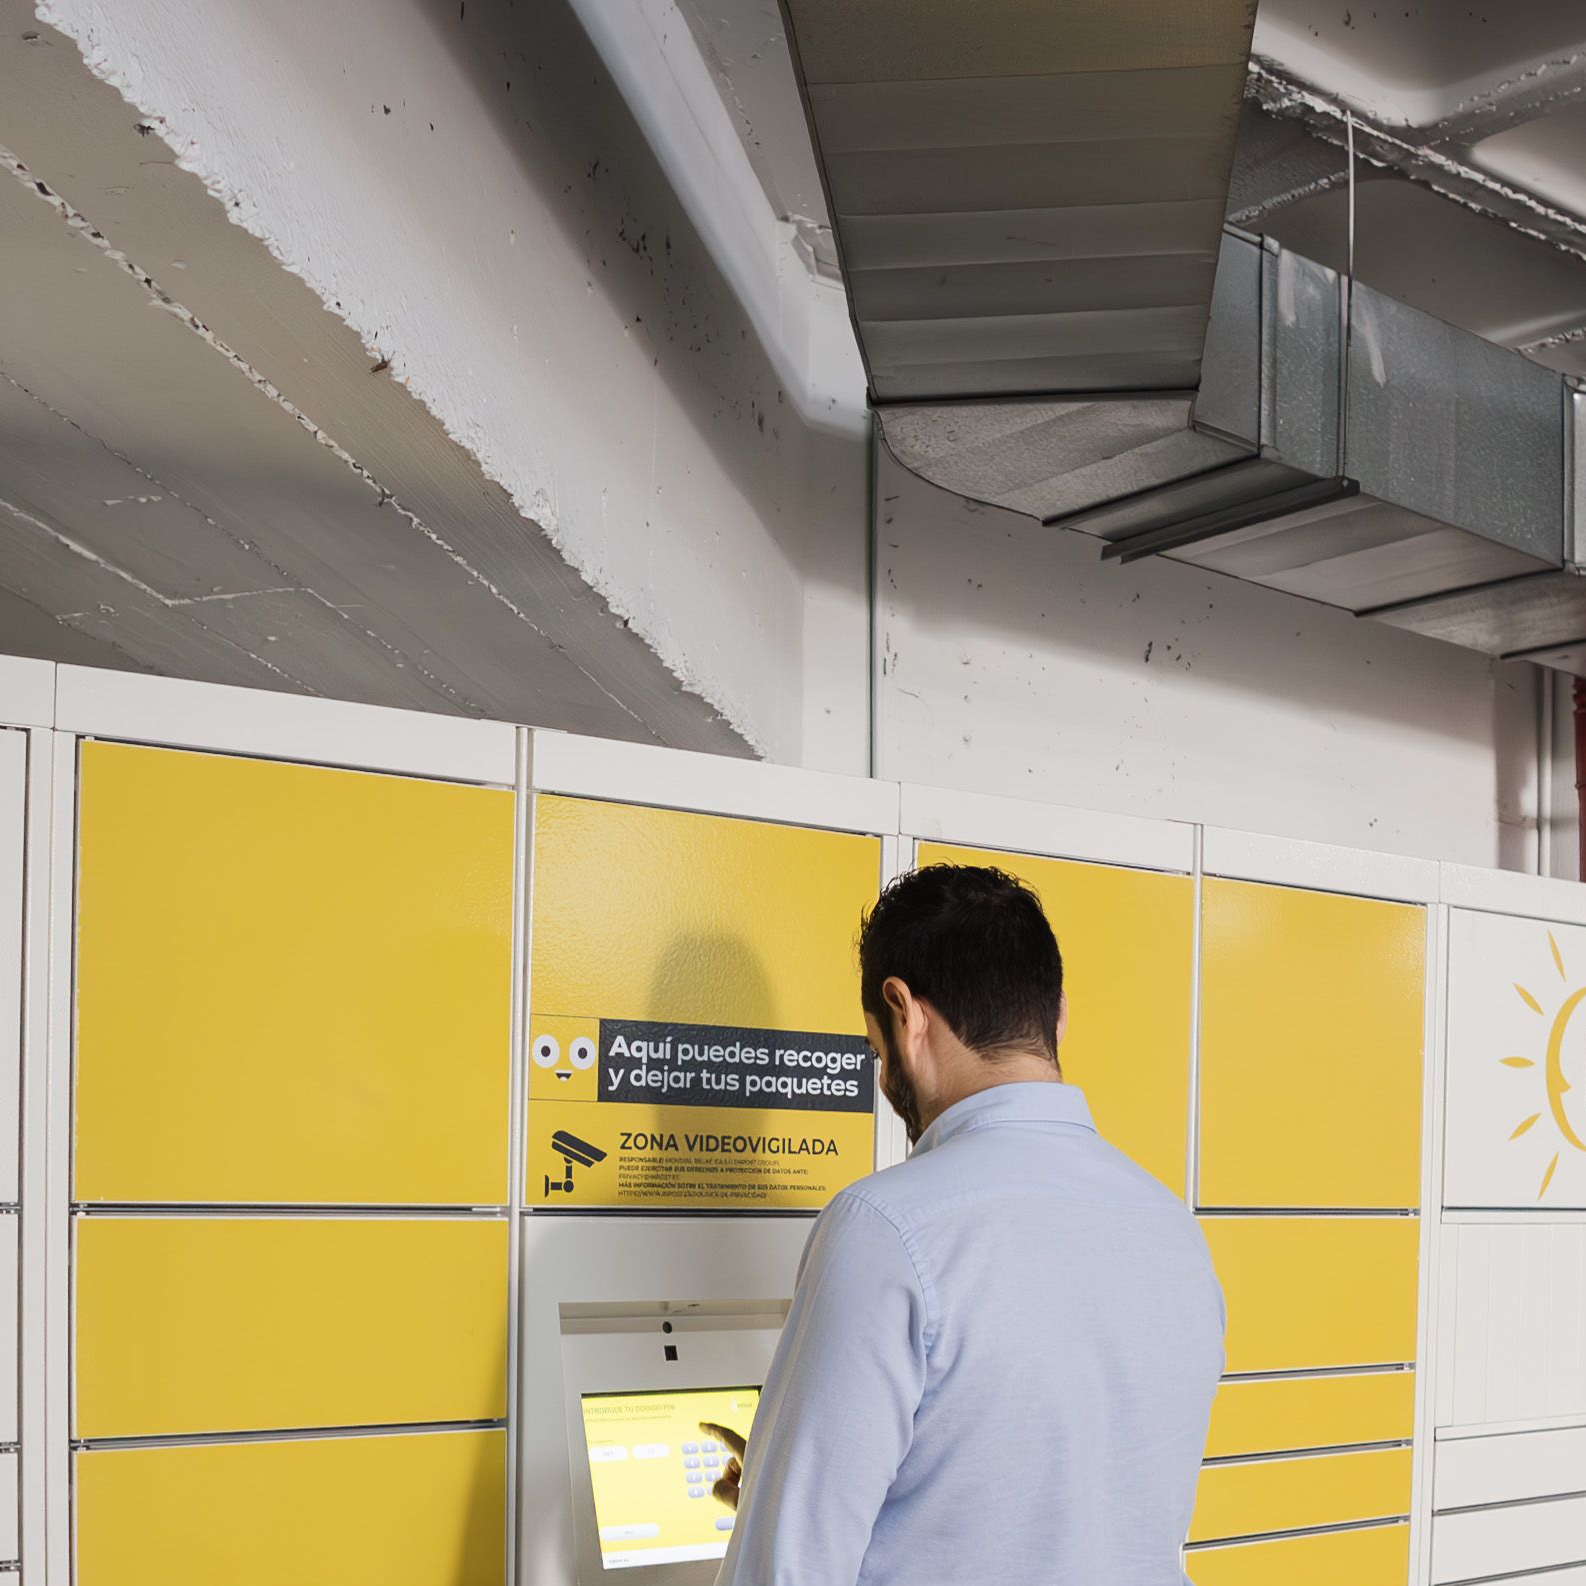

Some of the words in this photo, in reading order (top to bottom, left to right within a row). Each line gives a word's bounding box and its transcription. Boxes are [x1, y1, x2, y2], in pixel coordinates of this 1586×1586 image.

[607, 1034, 673, 1065] Aquí
[676, 1041, 770, 1066] puedes
[774, 1049, 866, 1074] recoger
[607, 1067, 625, 1092] y
[629, 1065, 696, 1094] dejar
[700, 1071, 740, 1092] tus
[745, 1073, 859, 1098] paquetes
[619, 1132, 679, 1153] ZONA
[684, 1133, 839, 1157] VIDEOVIGILADA
